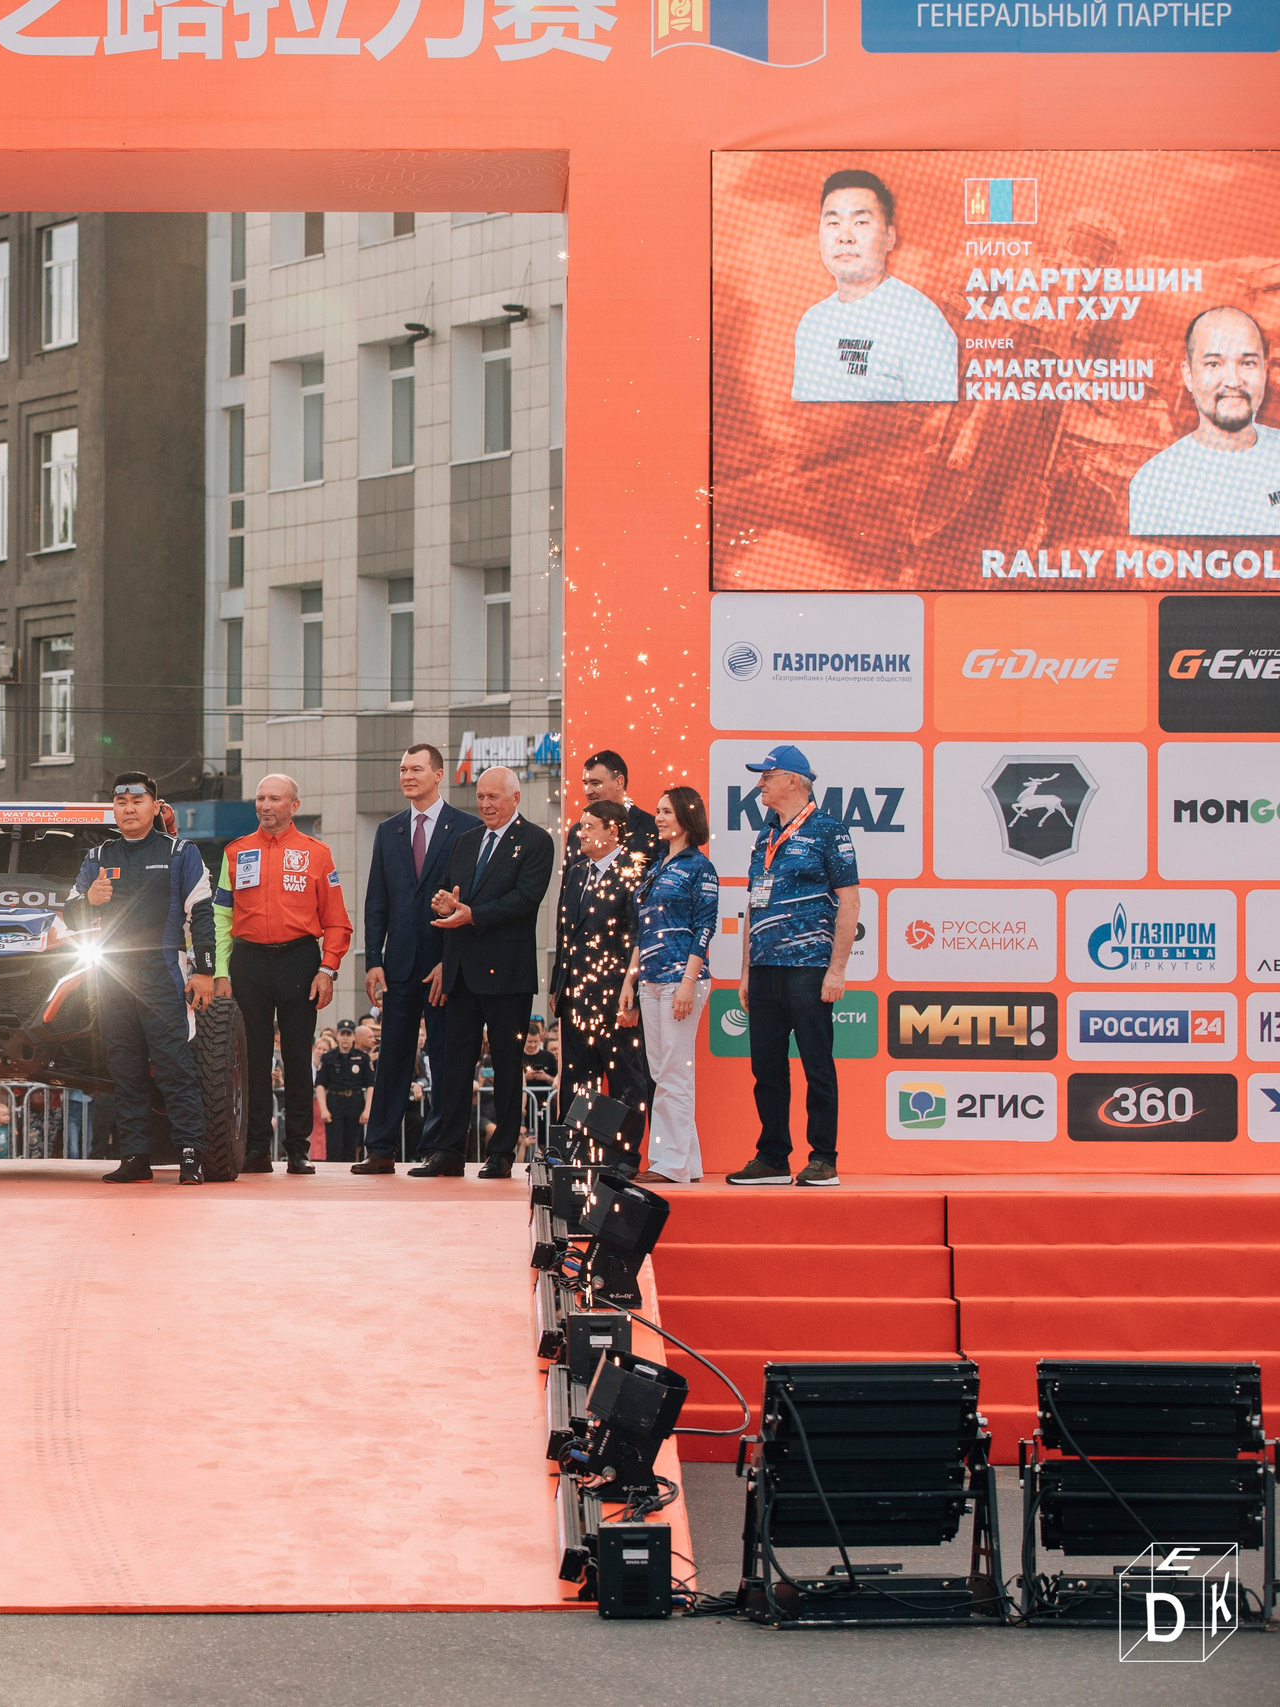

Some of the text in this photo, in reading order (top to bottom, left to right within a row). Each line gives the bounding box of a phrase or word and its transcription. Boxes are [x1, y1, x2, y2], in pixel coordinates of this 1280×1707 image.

[917, 0, 1233, 28] ГЕНЕРАЛЬНЫЙ ПАРТНЕР
[965, 241, 1032, 257] ПИЛОТ
[965, 267, 1203, 293] АМАРТУВШИН
[965, 296, 1141, 321] ХАСАГХУУ
[965, 338, 1014, 350] DRIVER
[847, 362, 868, 376] TEAM
[965, 358, 1154, 378] AMARTUVSHIN
[965, 381, 1145, 401] KHASAGKHUU
[981, 549, 1104, 579] RALLY
[772, 652, 911, 673] ГАЗПРОМБАНК
[283, 874, 307, 884] SILK
[283, 883, 307, 893] WAY
[942, 920, 1027, 935] РУССКАЯ
[1131, 922, 1216, 945] ГАЗПРОМ
[942, 936, 1039, 951] МЕХАНИКА
[1133, 948, 1214, 960] ДОБЫЧА
[1130, 961, 1216, 971] ИРКУТСК
[1089, 1016, 1222, 1037] РОССИЯ 24
[956, 1093, 1045, 1120] 2ГИС
[1112, 1086, 1194, 1123] 360
